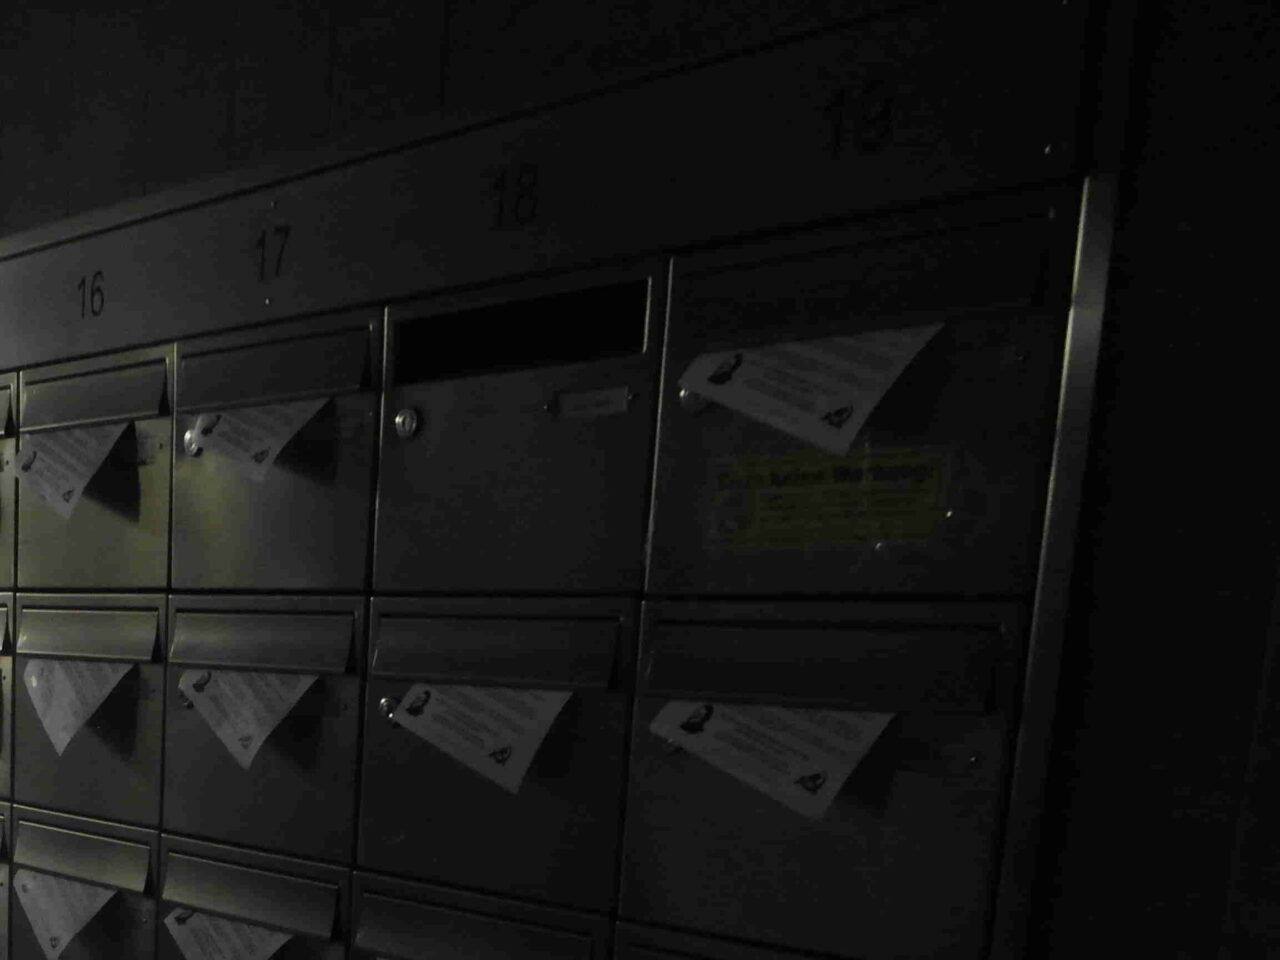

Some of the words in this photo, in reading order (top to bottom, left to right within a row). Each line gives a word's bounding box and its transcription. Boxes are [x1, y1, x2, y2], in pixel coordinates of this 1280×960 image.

[494, 163, 538, 226] 18
[257, 224, 291, 281] 17
[77, 270, 104, 319] 16
